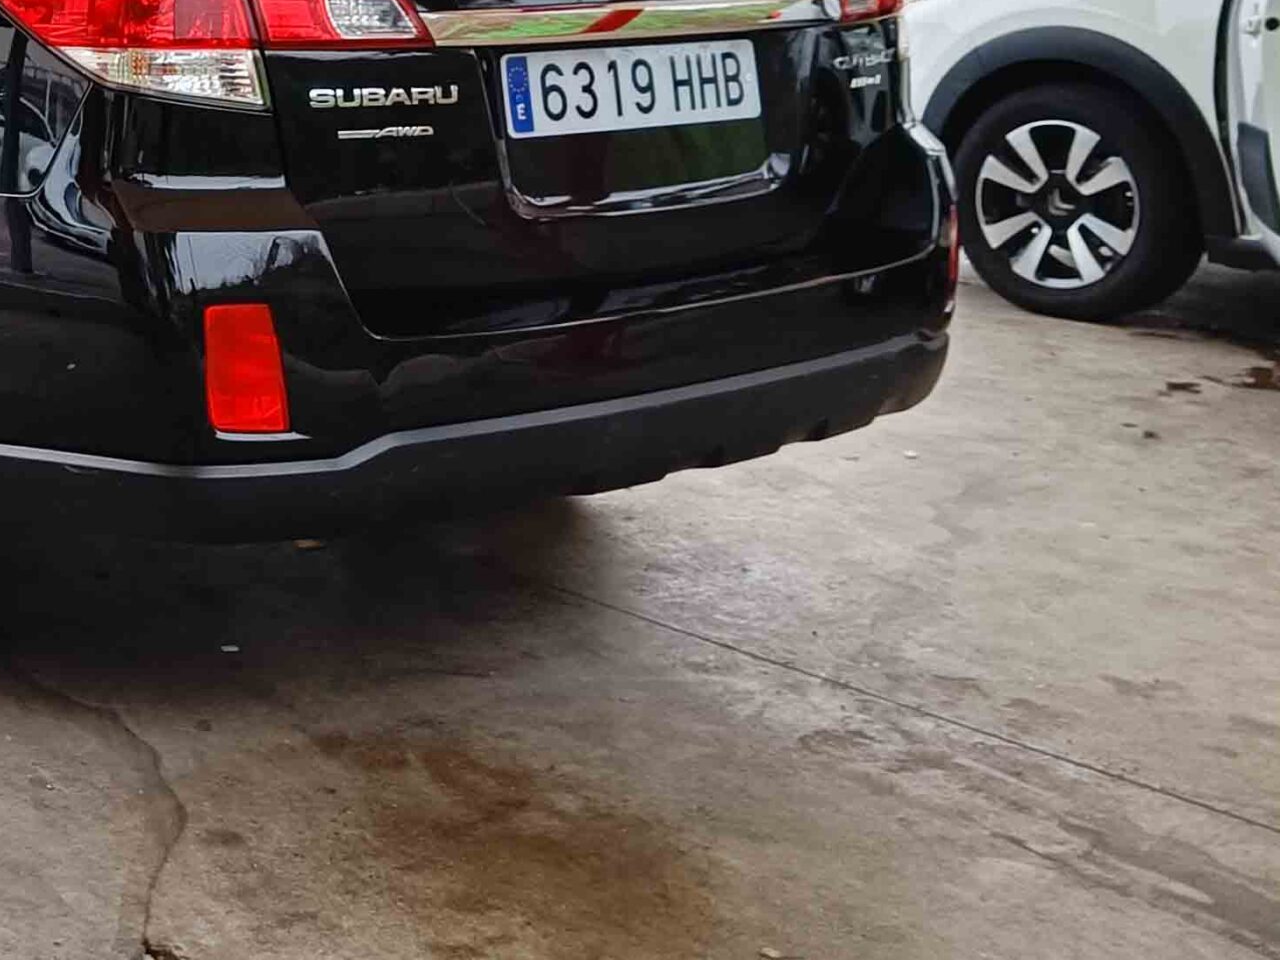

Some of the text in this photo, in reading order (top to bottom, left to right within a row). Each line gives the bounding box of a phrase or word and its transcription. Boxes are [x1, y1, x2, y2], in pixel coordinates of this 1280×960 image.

[309, 85, 458, 108] SUBARU
[540, 52, 745, 121] 6319 HHB
[517, 103, 527, 121] E
[375, 126, 434, 138] AWD
